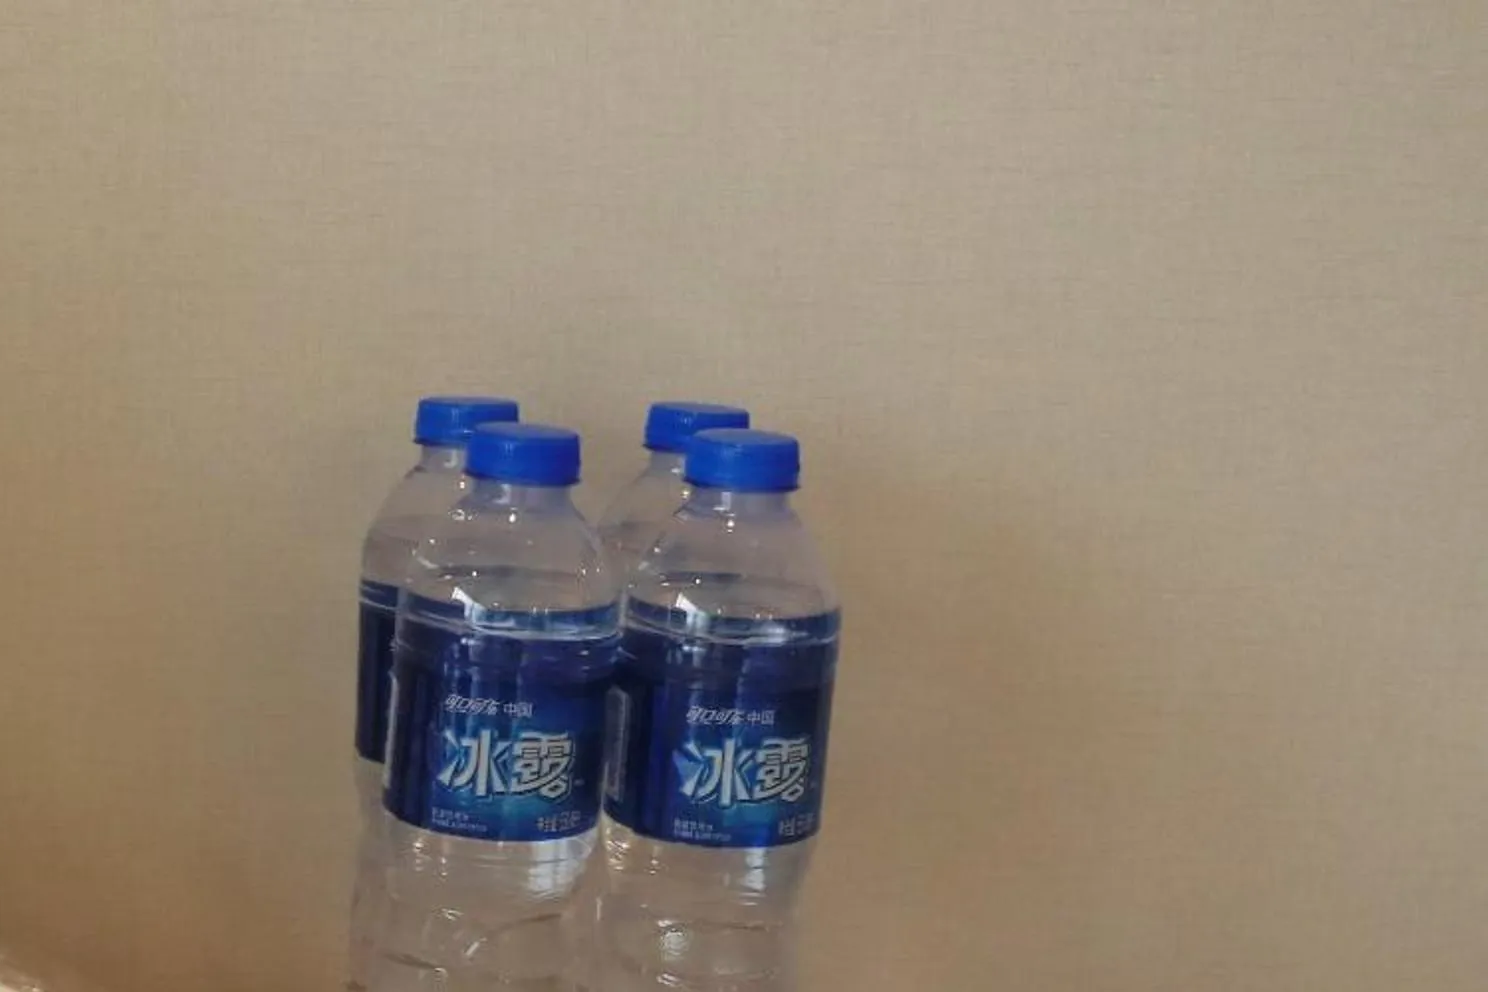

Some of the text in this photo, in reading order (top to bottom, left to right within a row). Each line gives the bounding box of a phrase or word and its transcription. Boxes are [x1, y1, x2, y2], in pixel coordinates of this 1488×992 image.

[503, 702, 533, 718] 中国
[747, 709, 776, 725] 中国
[437, 729, 574, 799] 冰露
[679, 737, 810, 807] 冰露
